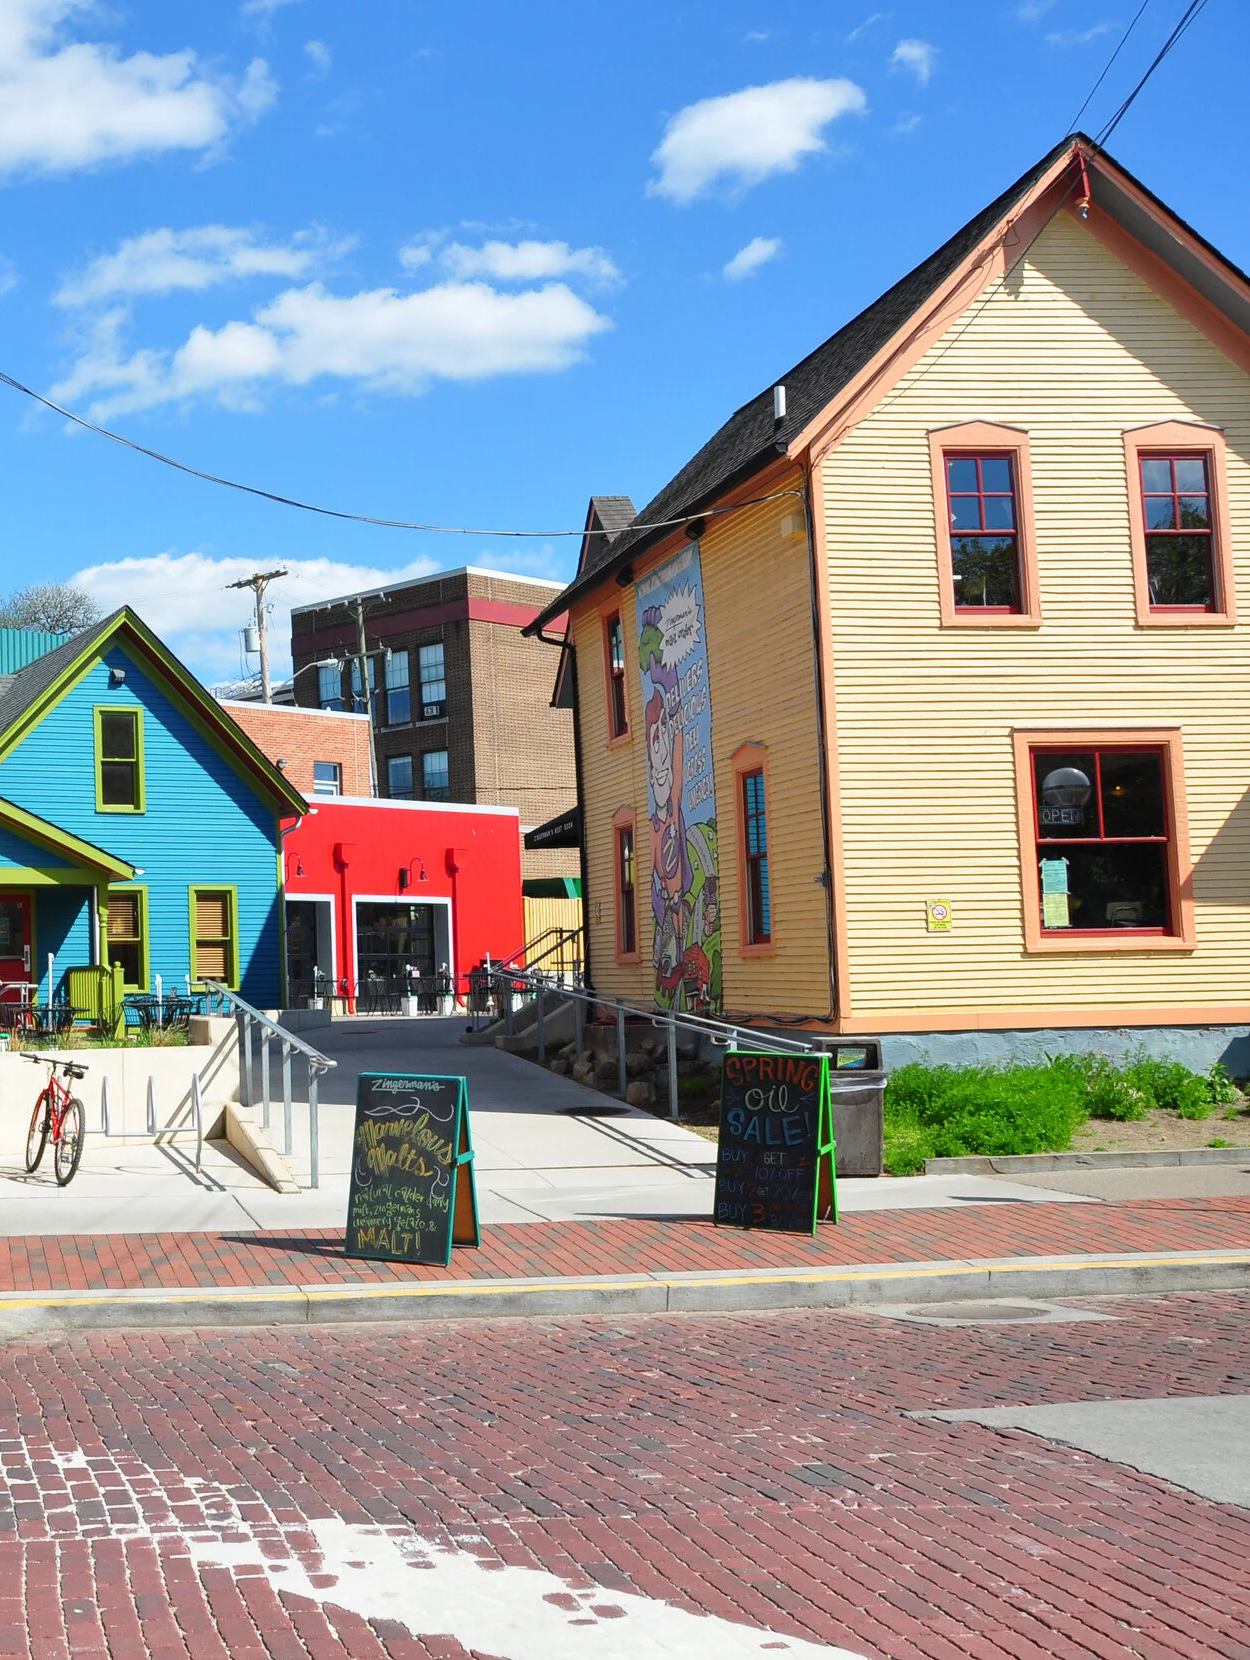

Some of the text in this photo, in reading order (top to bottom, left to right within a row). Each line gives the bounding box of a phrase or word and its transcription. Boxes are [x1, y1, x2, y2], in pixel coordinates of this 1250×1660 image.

[371, 1078, 446, 1095] Zingerman's
[725, 1056, 820, 1092] SPRING
[744, 1084, 800, 1113] oil
[357, 1113, 453, 1166] Marvelous
[726, 1108, 812, 1146] SALE!
[367, 1143, 434, 1177] Malts
[721, 1149, 788, 1166] BUY GET
[718, 1178, 746, 1196] BUY
[779, 1168, 806, 1181] OFF
[429, 1220, 438, 1231] &
[717, 1202, 748, 1222] BUY
[750, 1203, 767, 1224] 3
[357, 1226, 422, 1256] MALT!
